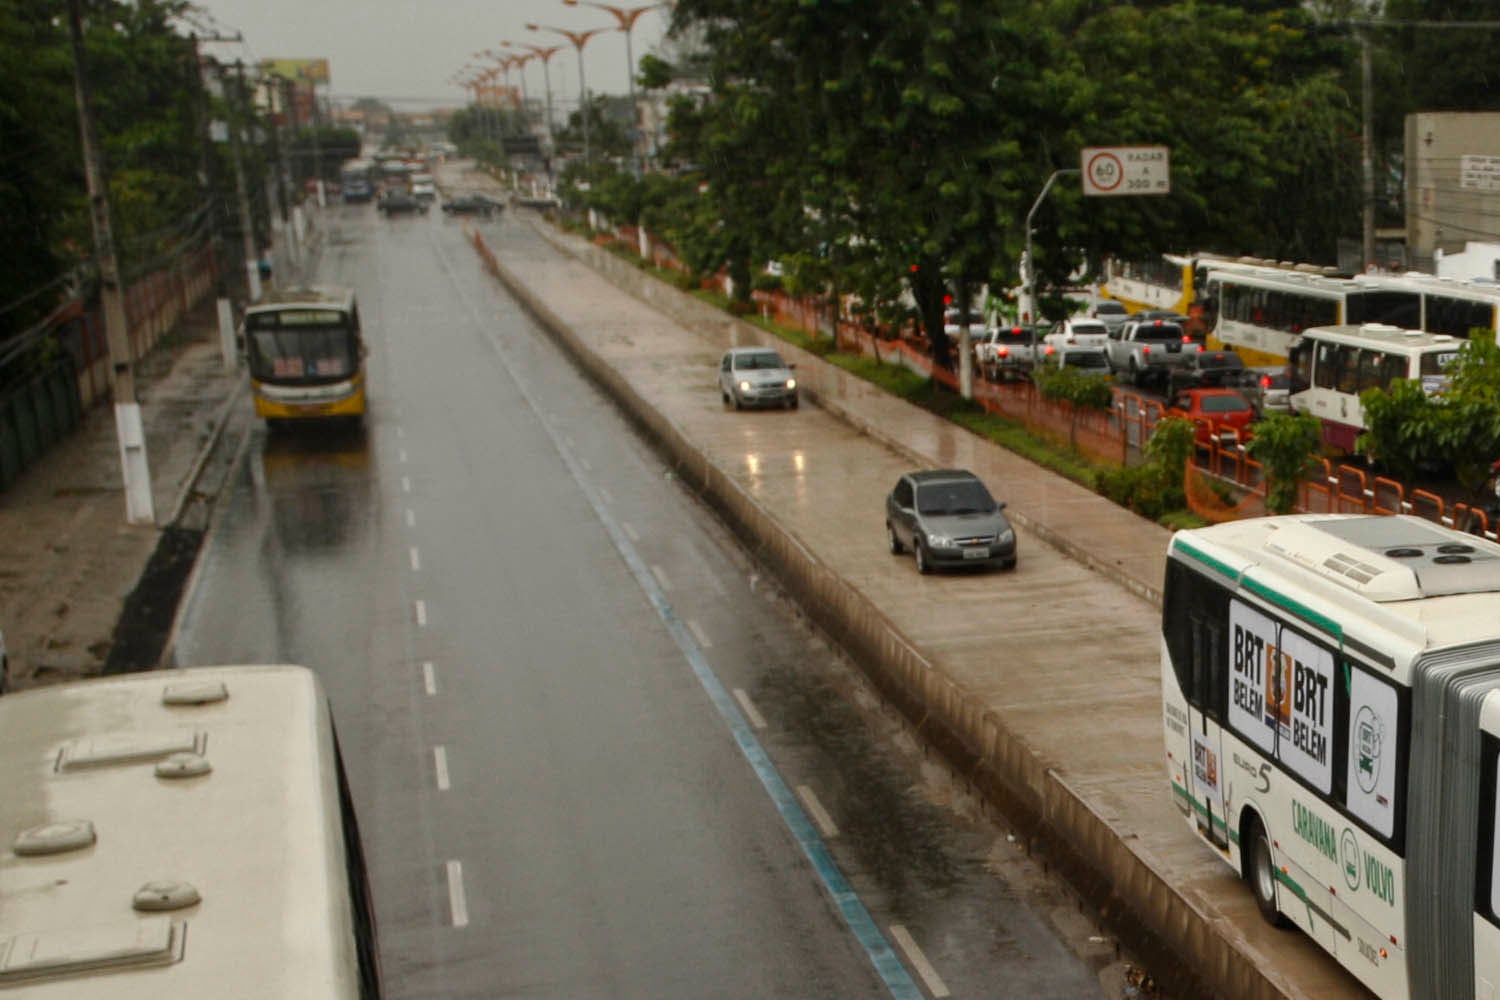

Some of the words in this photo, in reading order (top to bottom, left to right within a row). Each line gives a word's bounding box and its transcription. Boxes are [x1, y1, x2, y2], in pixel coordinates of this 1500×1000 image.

[1234, 622, 1264, 687] BRT
[1293, 658, 1329, 729] BRT
[1252, 762, 1273, 794] 5
[1290, 798, 1338, 866] CARAVANA
[1362, 848, 1396, 908] VOLVO
